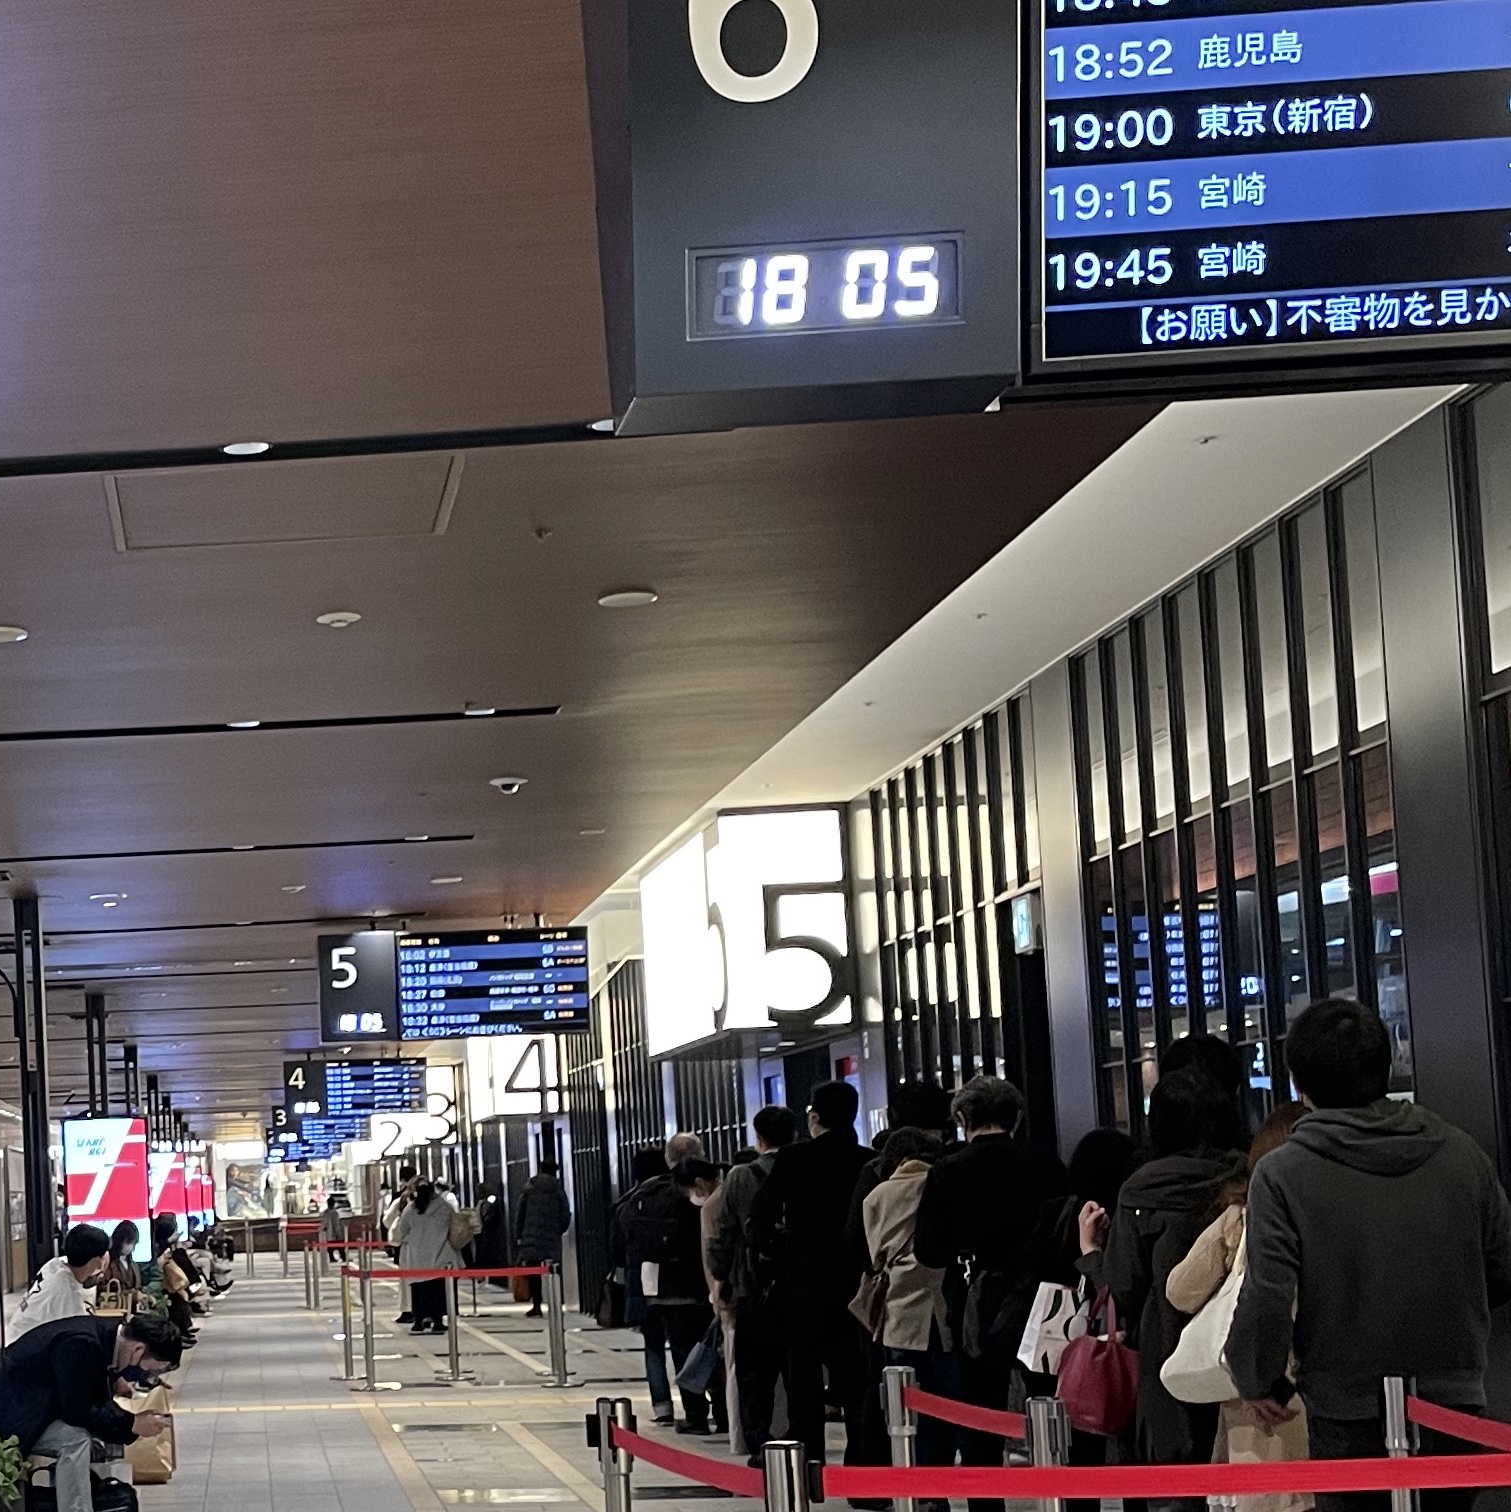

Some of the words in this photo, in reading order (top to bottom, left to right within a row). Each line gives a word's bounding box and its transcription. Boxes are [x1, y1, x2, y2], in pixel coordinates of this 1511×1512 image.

[1048, 38, 1174, 82] 18:52
[1197, 29, 1303, 70] 鹿児島
[1048, 108, 1174, 153] 19:00
[1048, 178, 1174, 221] 19:15
[1198, 171, 1267, 210] 宮崎
[841, 246, 939, 320] 05
[1048, 247, 1174, 291] 19:45
[1197, 240, 1267, 279] 宮崎
[331, 946, 358, 989] 5
[761, 880, 850, 1030] 5
[288, 1067, 306, 1090] 4
[504, 1038, 558, 1116] 4
[275, 1109, 287, 1127] 3
